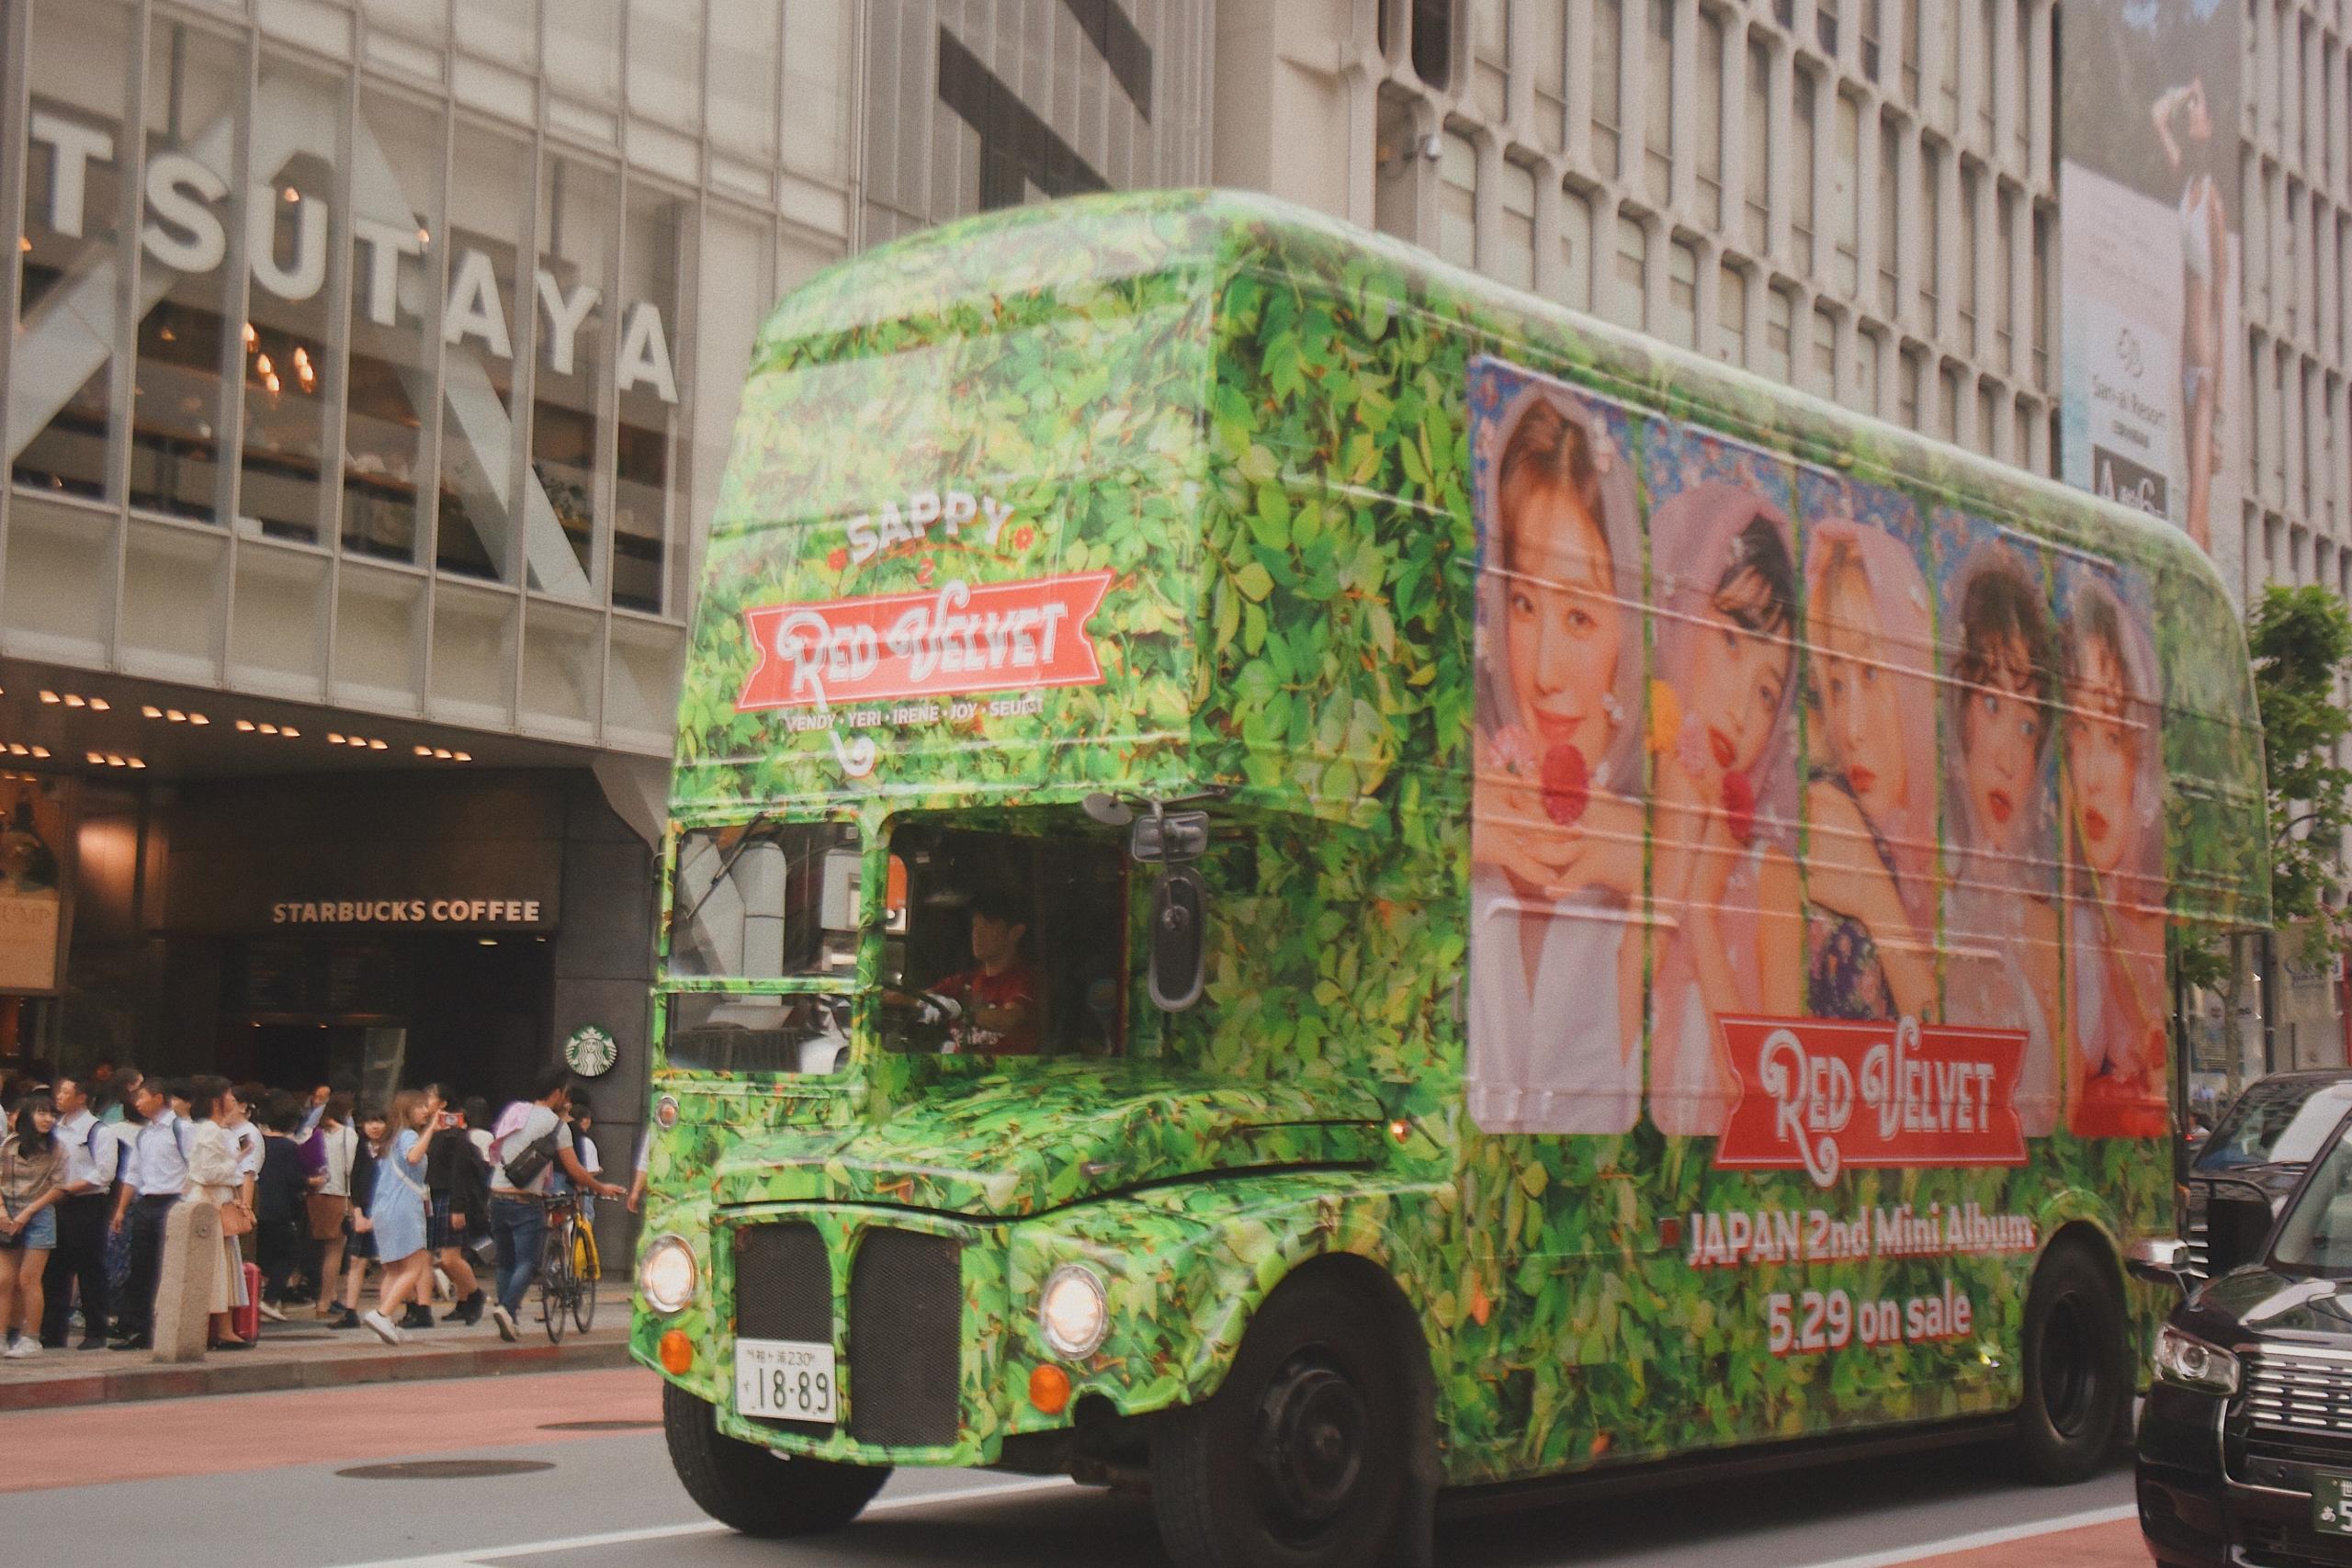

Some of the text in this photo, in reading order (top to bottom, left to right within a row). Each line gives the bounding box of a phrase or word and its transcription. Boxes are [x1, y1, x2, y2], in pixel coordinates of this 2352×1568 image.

[30, 112, 679, 404] TSUTAYA
[846, 491, 1015, 563] SAPPY
[848, 710, 882, 728] YERI
[893, 705, 939, 725] IRENE
[950, 703, 978, 720] JOY
[274, 900, 540, 923] STARBUCKS COFFEE
[1758, 1016, 1996, 1188] RED VELVET
[1688, 1201, 2036, 1268] JAPAN 2nd Mini Album
[1768, 1279, 1973, 1355] 5.29 on sale
